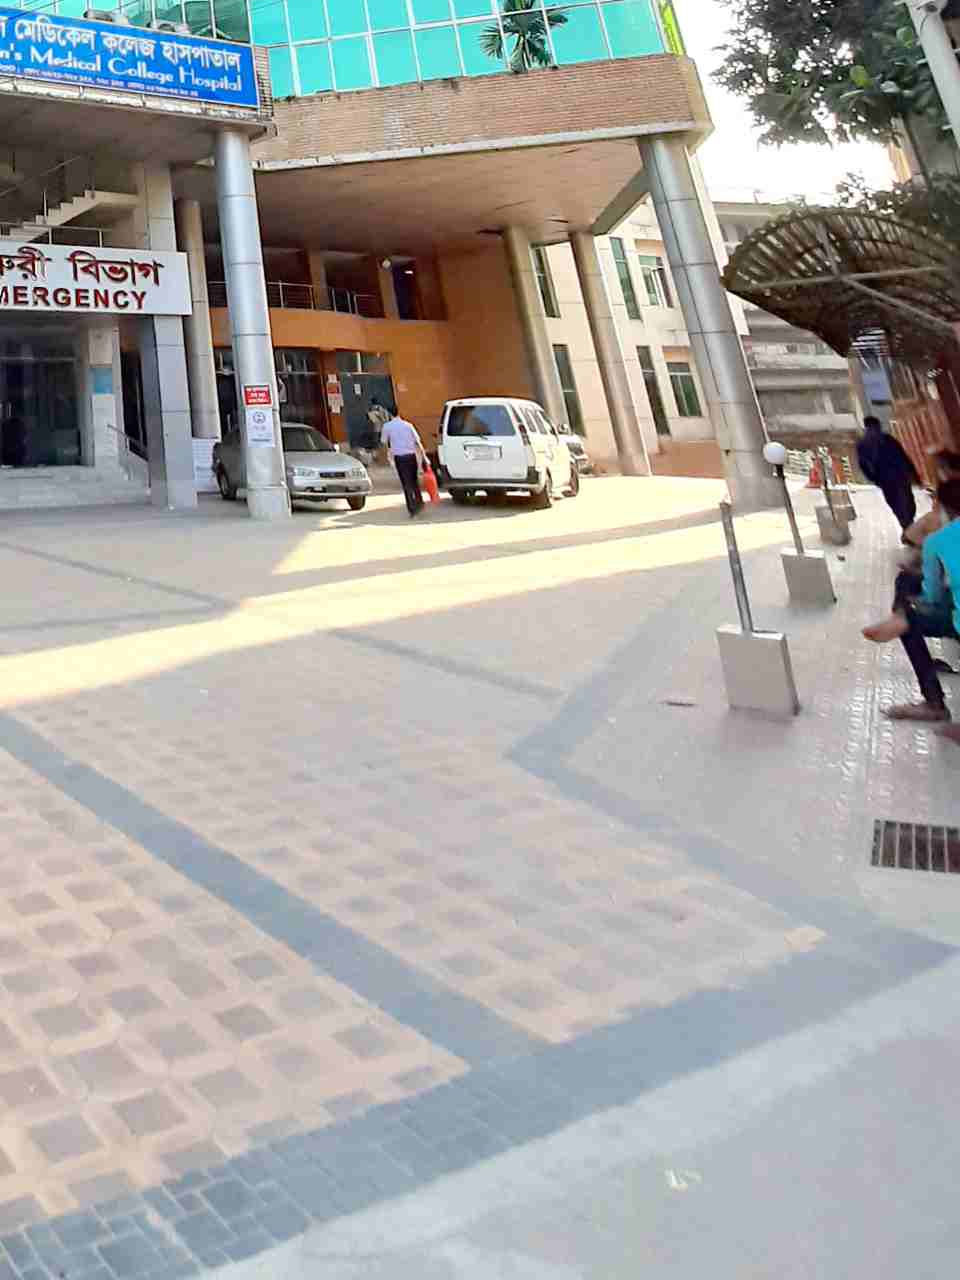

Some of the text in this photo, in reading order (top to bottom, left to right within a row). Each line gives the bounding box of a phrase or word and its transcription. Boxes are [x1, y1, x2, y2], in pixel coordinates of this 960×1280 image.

[14, 14, 97, 51] মেডিকেল
[102, 34, 157, 61] কলেজ
[160, 42, 241, 74] হাসপাতাল
[30, 45, 102, 73] Medical
[108, 58, 175, 84] College
[178, 66, 243, 92] Hospital
[67, 250, 165, 287] বিভাগ
